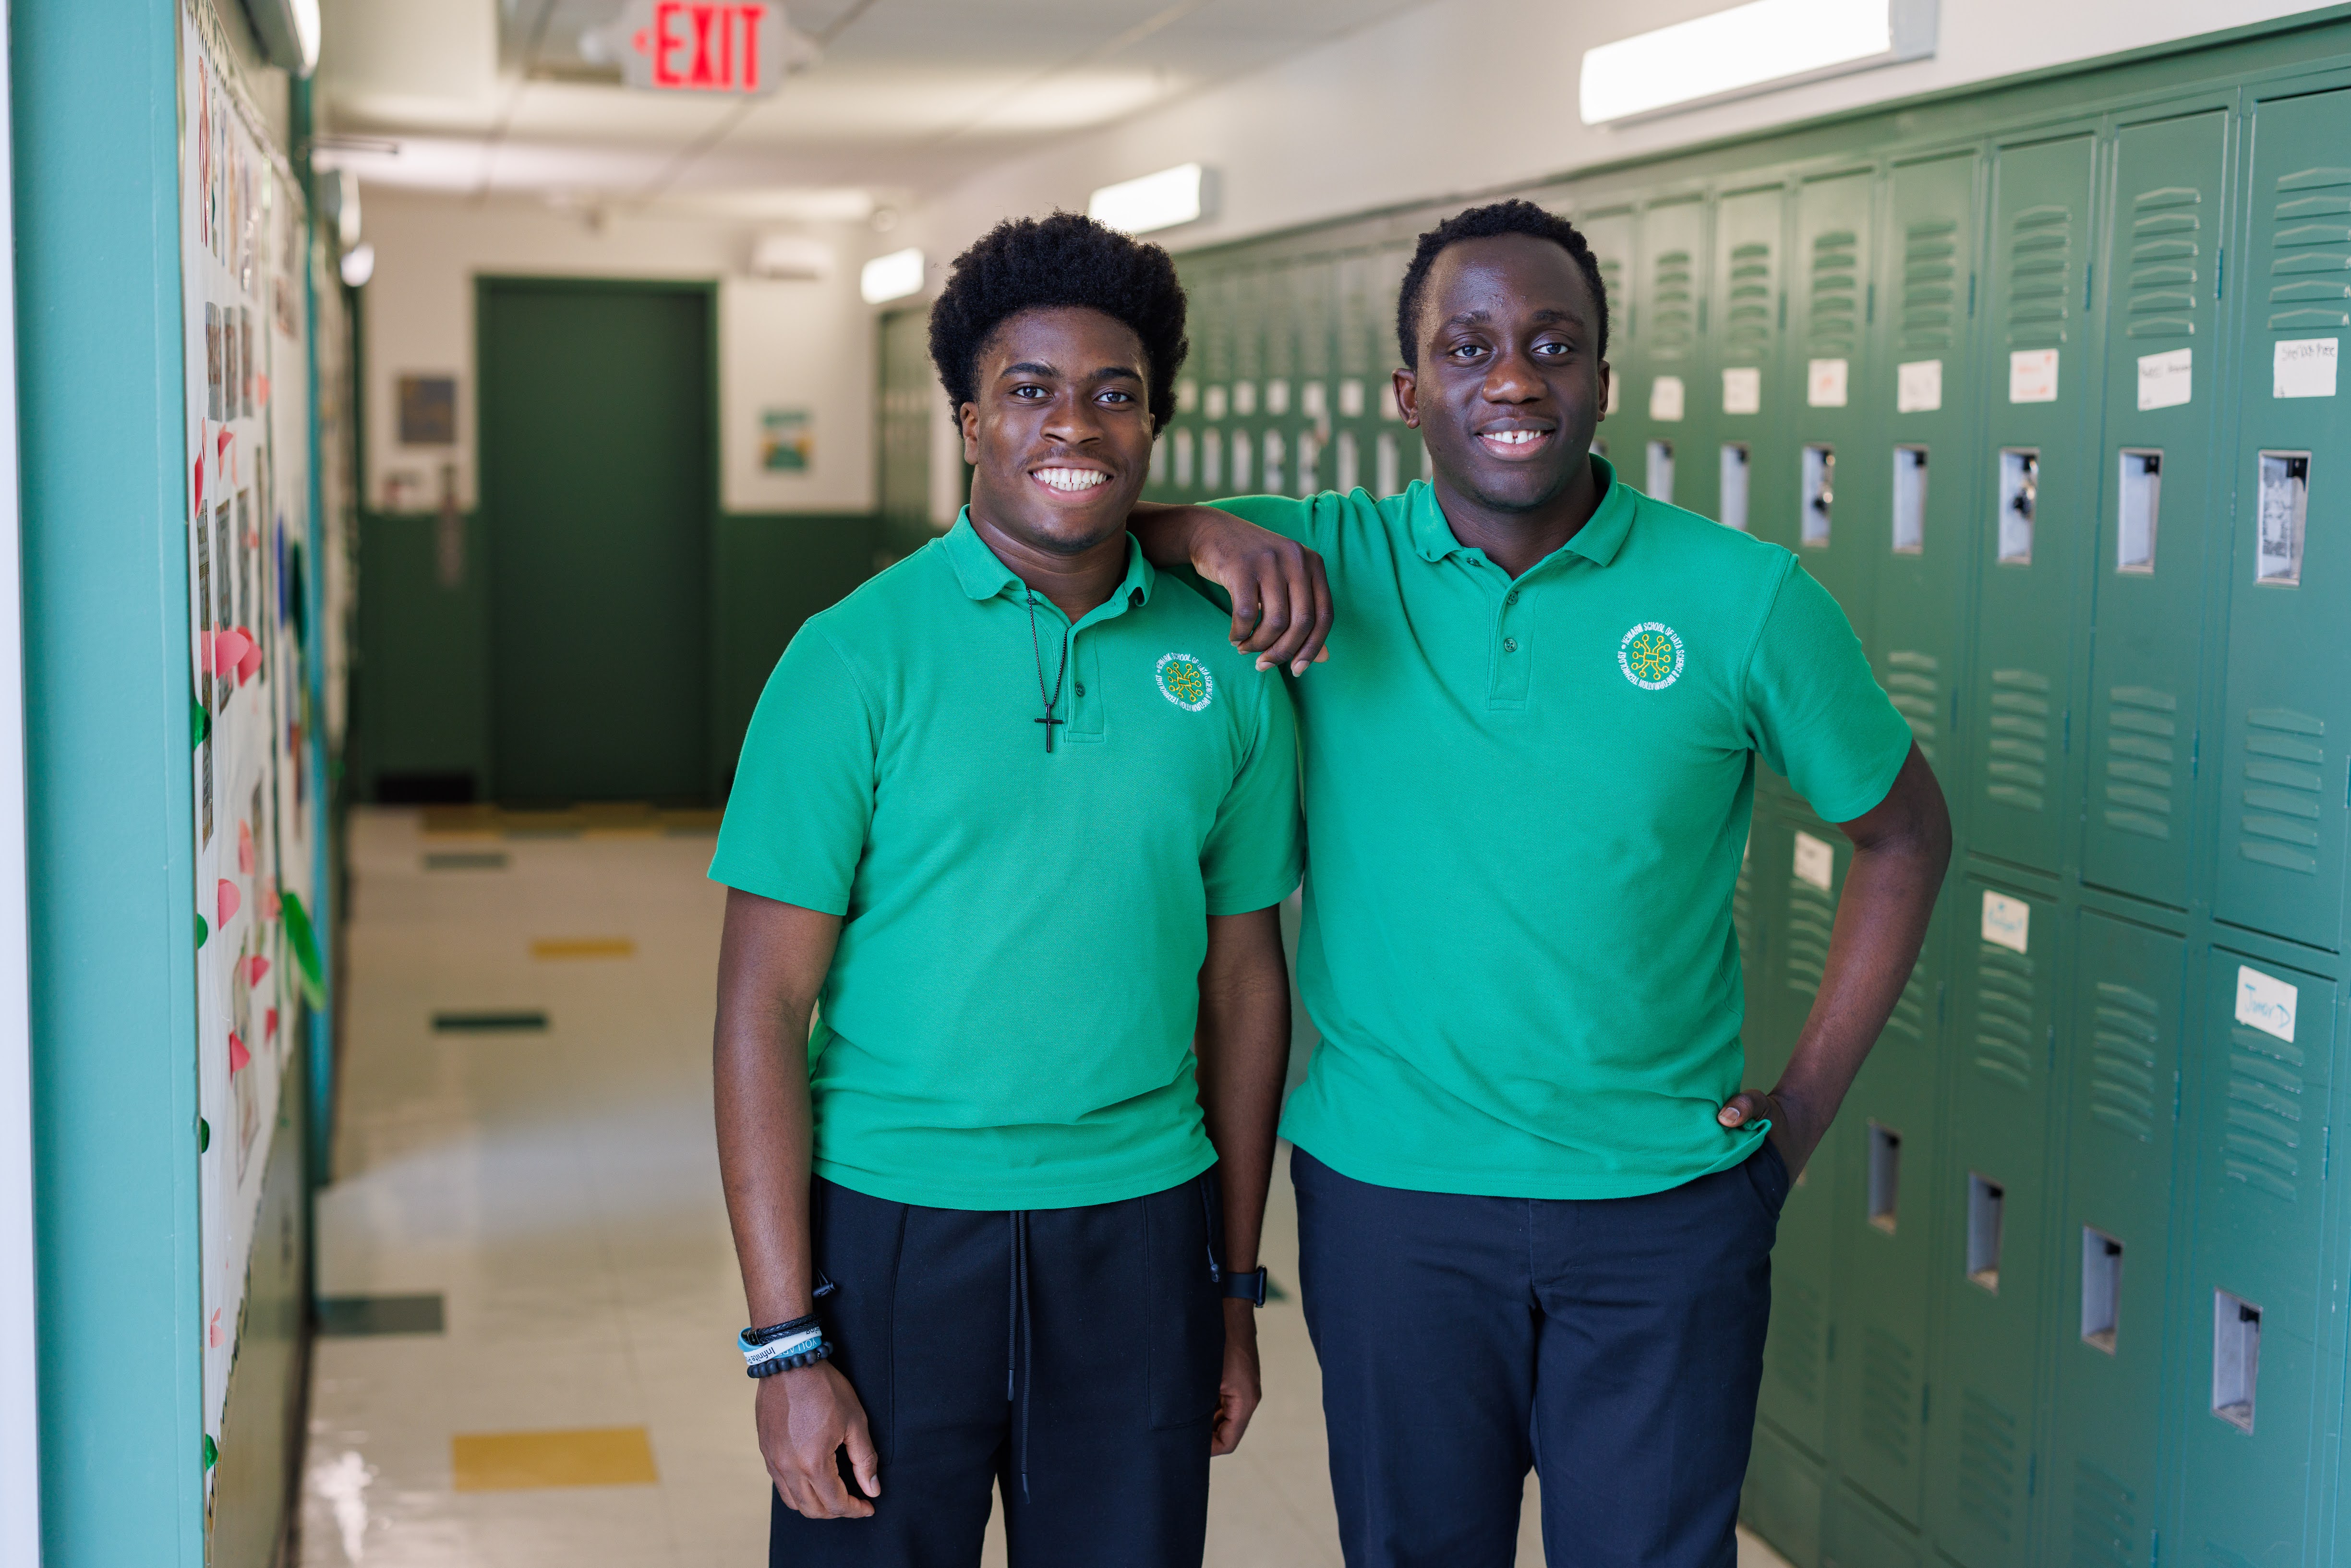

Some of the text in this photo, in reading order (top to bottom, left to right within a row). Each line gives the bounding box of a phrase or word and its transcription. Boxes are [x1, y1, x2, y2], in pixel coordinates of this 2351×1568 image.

[654, 1, 766, 91] EXIT
[1621, 623, 1643, 645] NEWARK
[1643, 622, 1665, 633] SCHOOL
[1665, 627, 1674, 636] OF
[1670, 633, 1683, 649] DATA
[1156, 653, 1172, 670] NEWARK
[1171, 652, 1191, 661] SCHOOL
[1617, 651, 1639, 685] TECHNOLOGY
[1638, 674, 1676, 690] INFORMATION
[798, 1338, 817, 1351] YOU
[750, 1347, 776, 1362] Infinite
